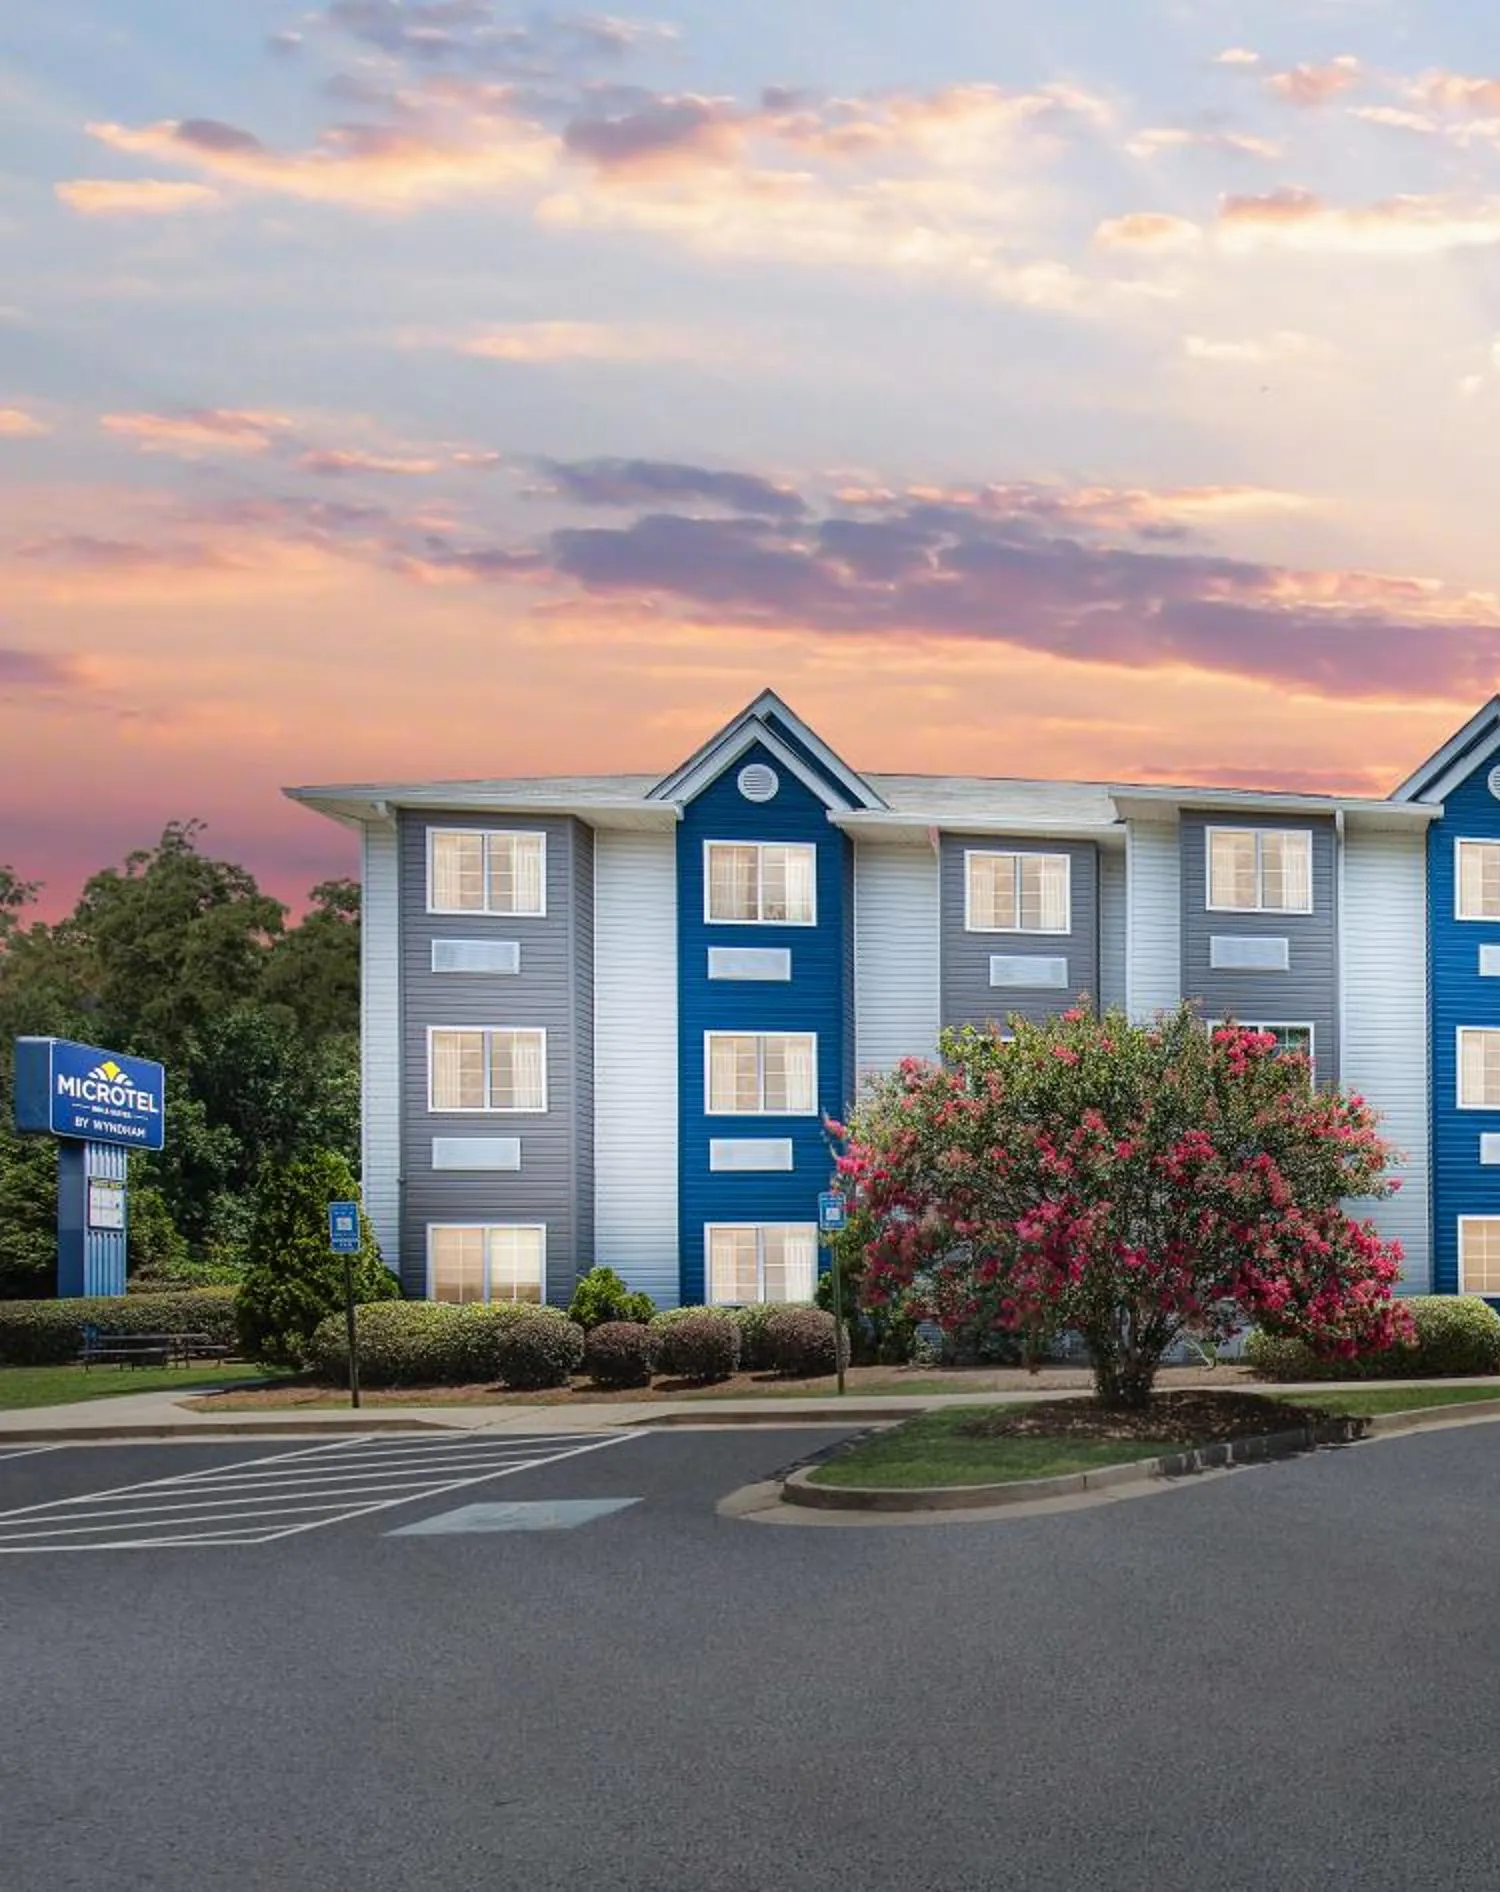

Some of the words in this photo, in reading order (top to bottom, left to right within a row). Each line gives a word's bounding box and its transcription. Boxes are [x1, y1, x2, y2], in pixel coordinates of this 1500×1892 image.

[57, 1073, 159, 1113] MICROTEL
[75, 1115, 89, 1128] BY
[93, 1119, 146, 1138] WYNDHAM
